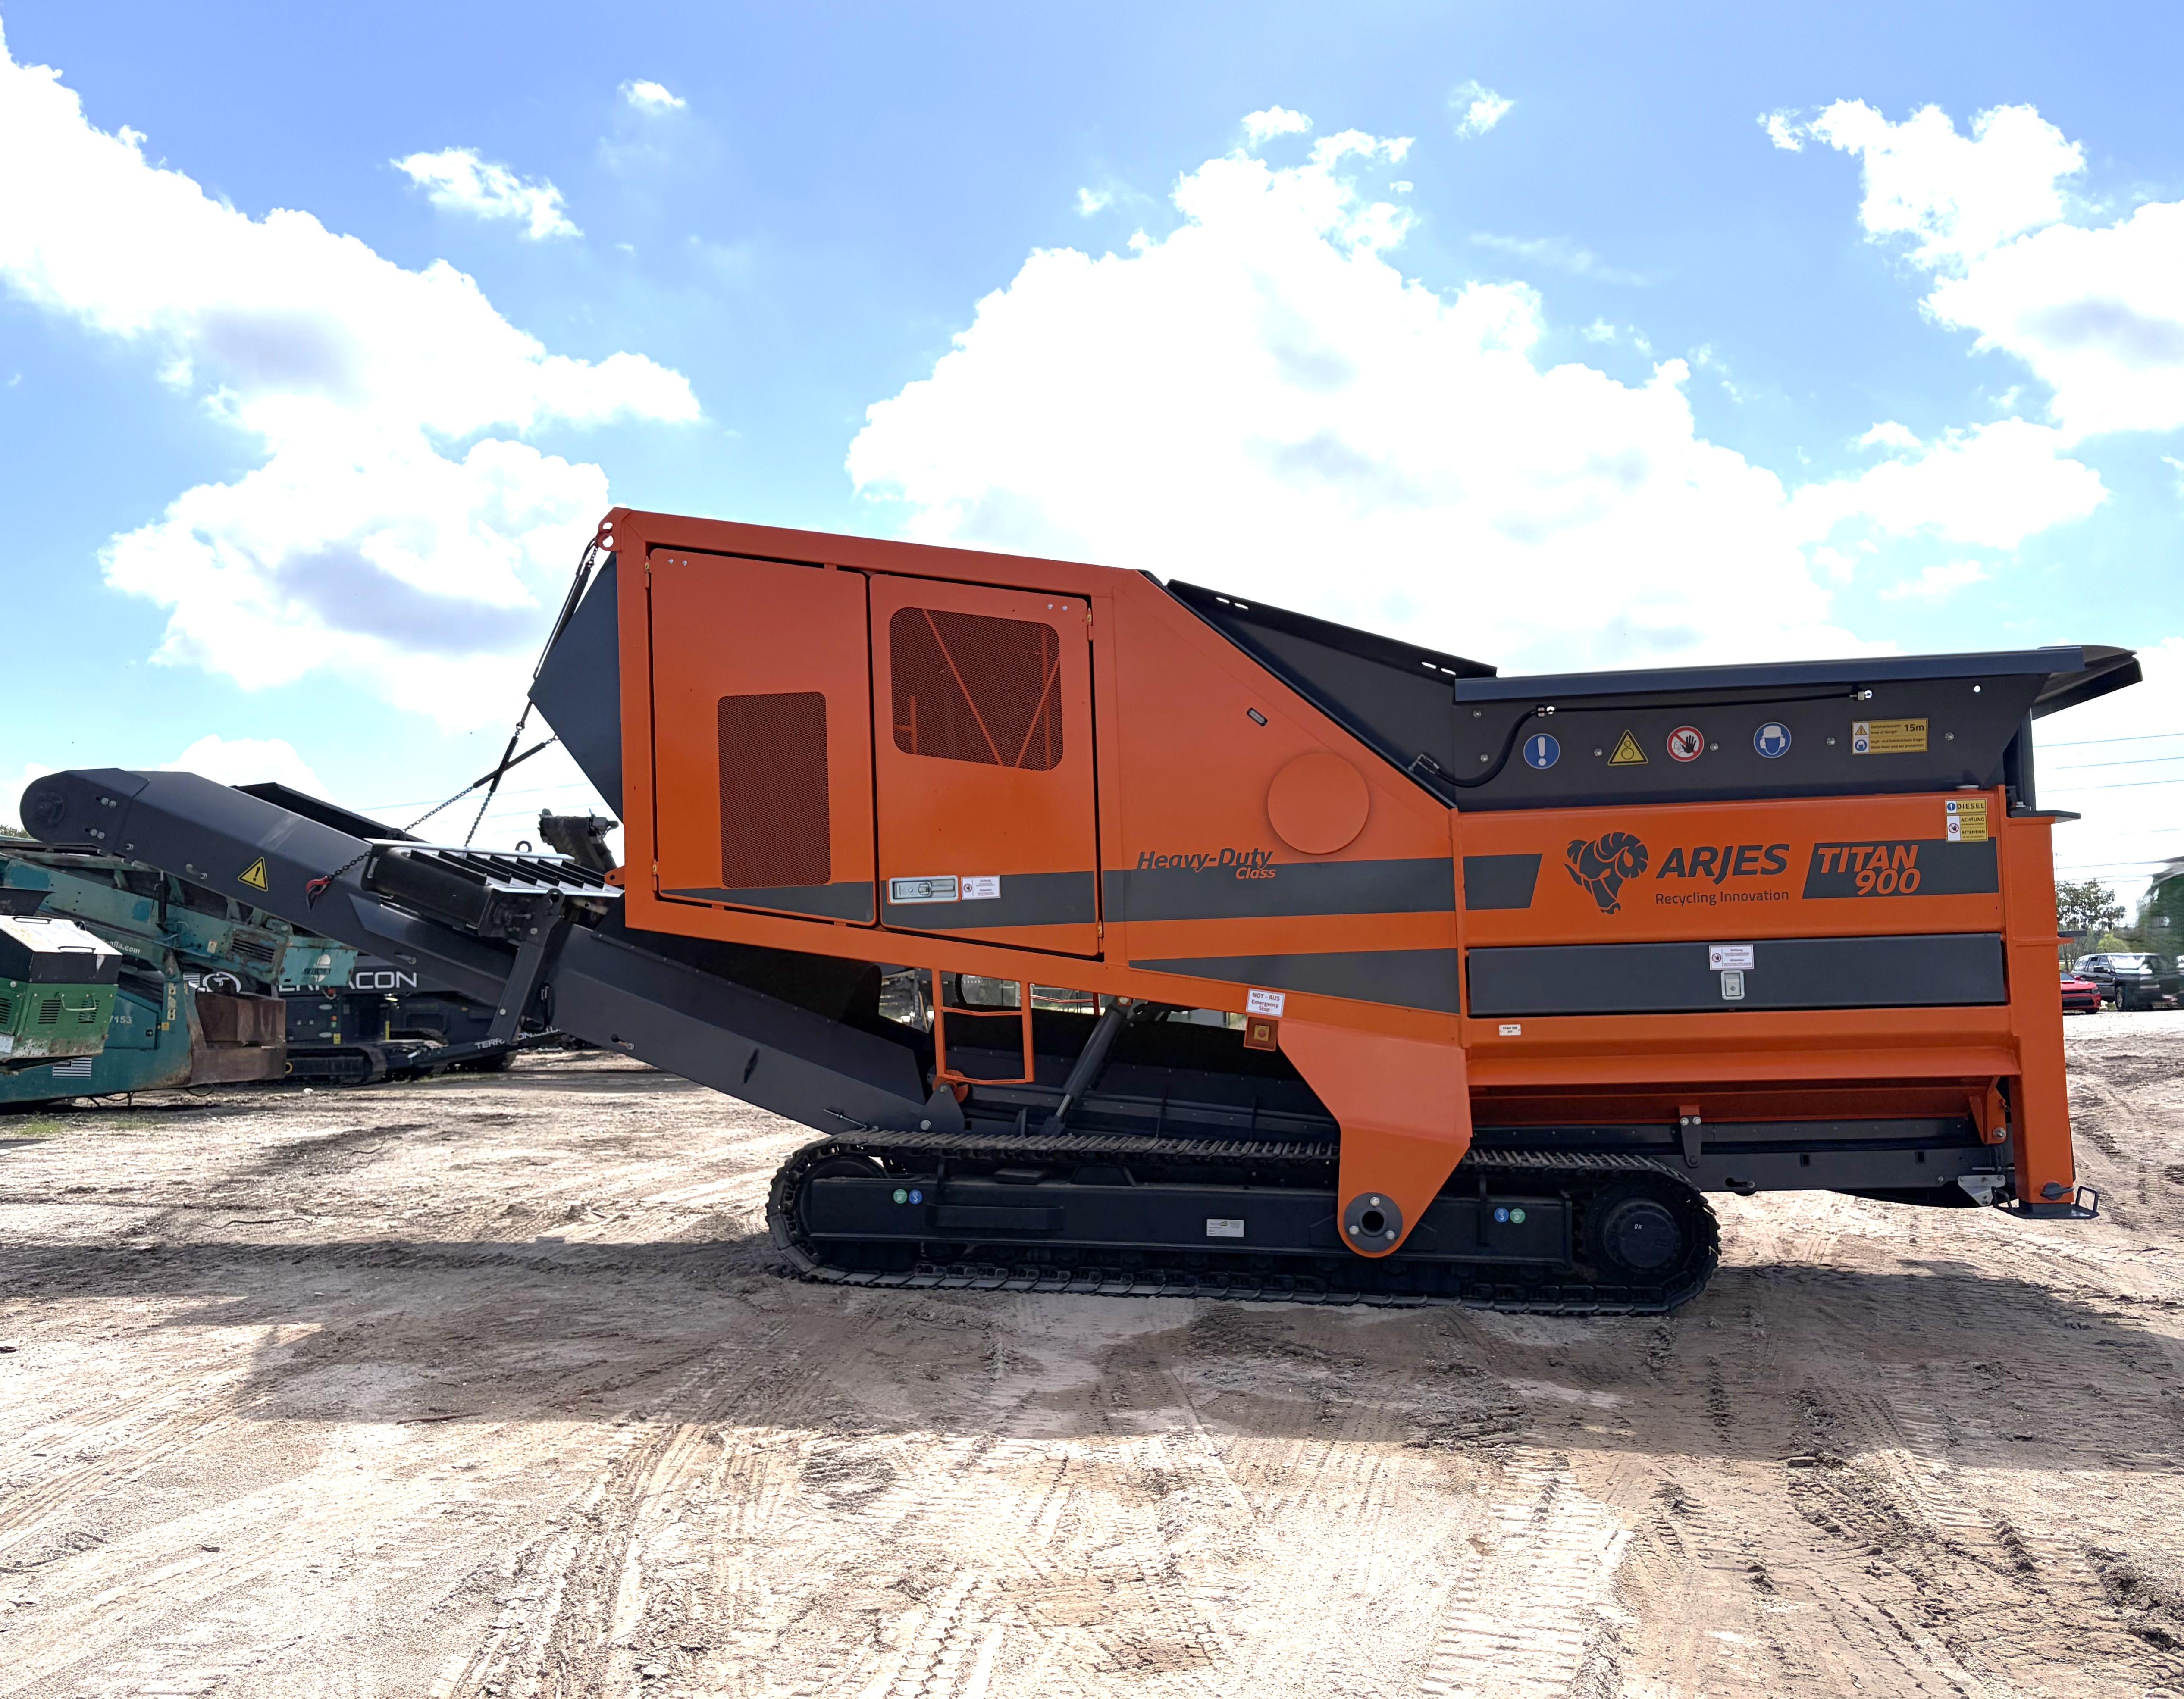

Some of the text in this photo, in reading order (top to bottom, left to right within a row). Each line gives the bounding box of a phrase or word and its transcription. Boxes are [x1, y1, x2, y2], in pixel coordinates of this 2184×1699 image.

[1137, 848, 1273, 873] Heavy-Duty
[1656, 843, 1790, 885] ARJES
[1818, 845, 1918, 873] TITAN
[1236, 867, 1277, 879] Class
[1855, 868, 1921, 895] 900
[1655, 889, 1789, 907] Recycling Innovation
[1251, 999, 1279, 1008] Emergency
